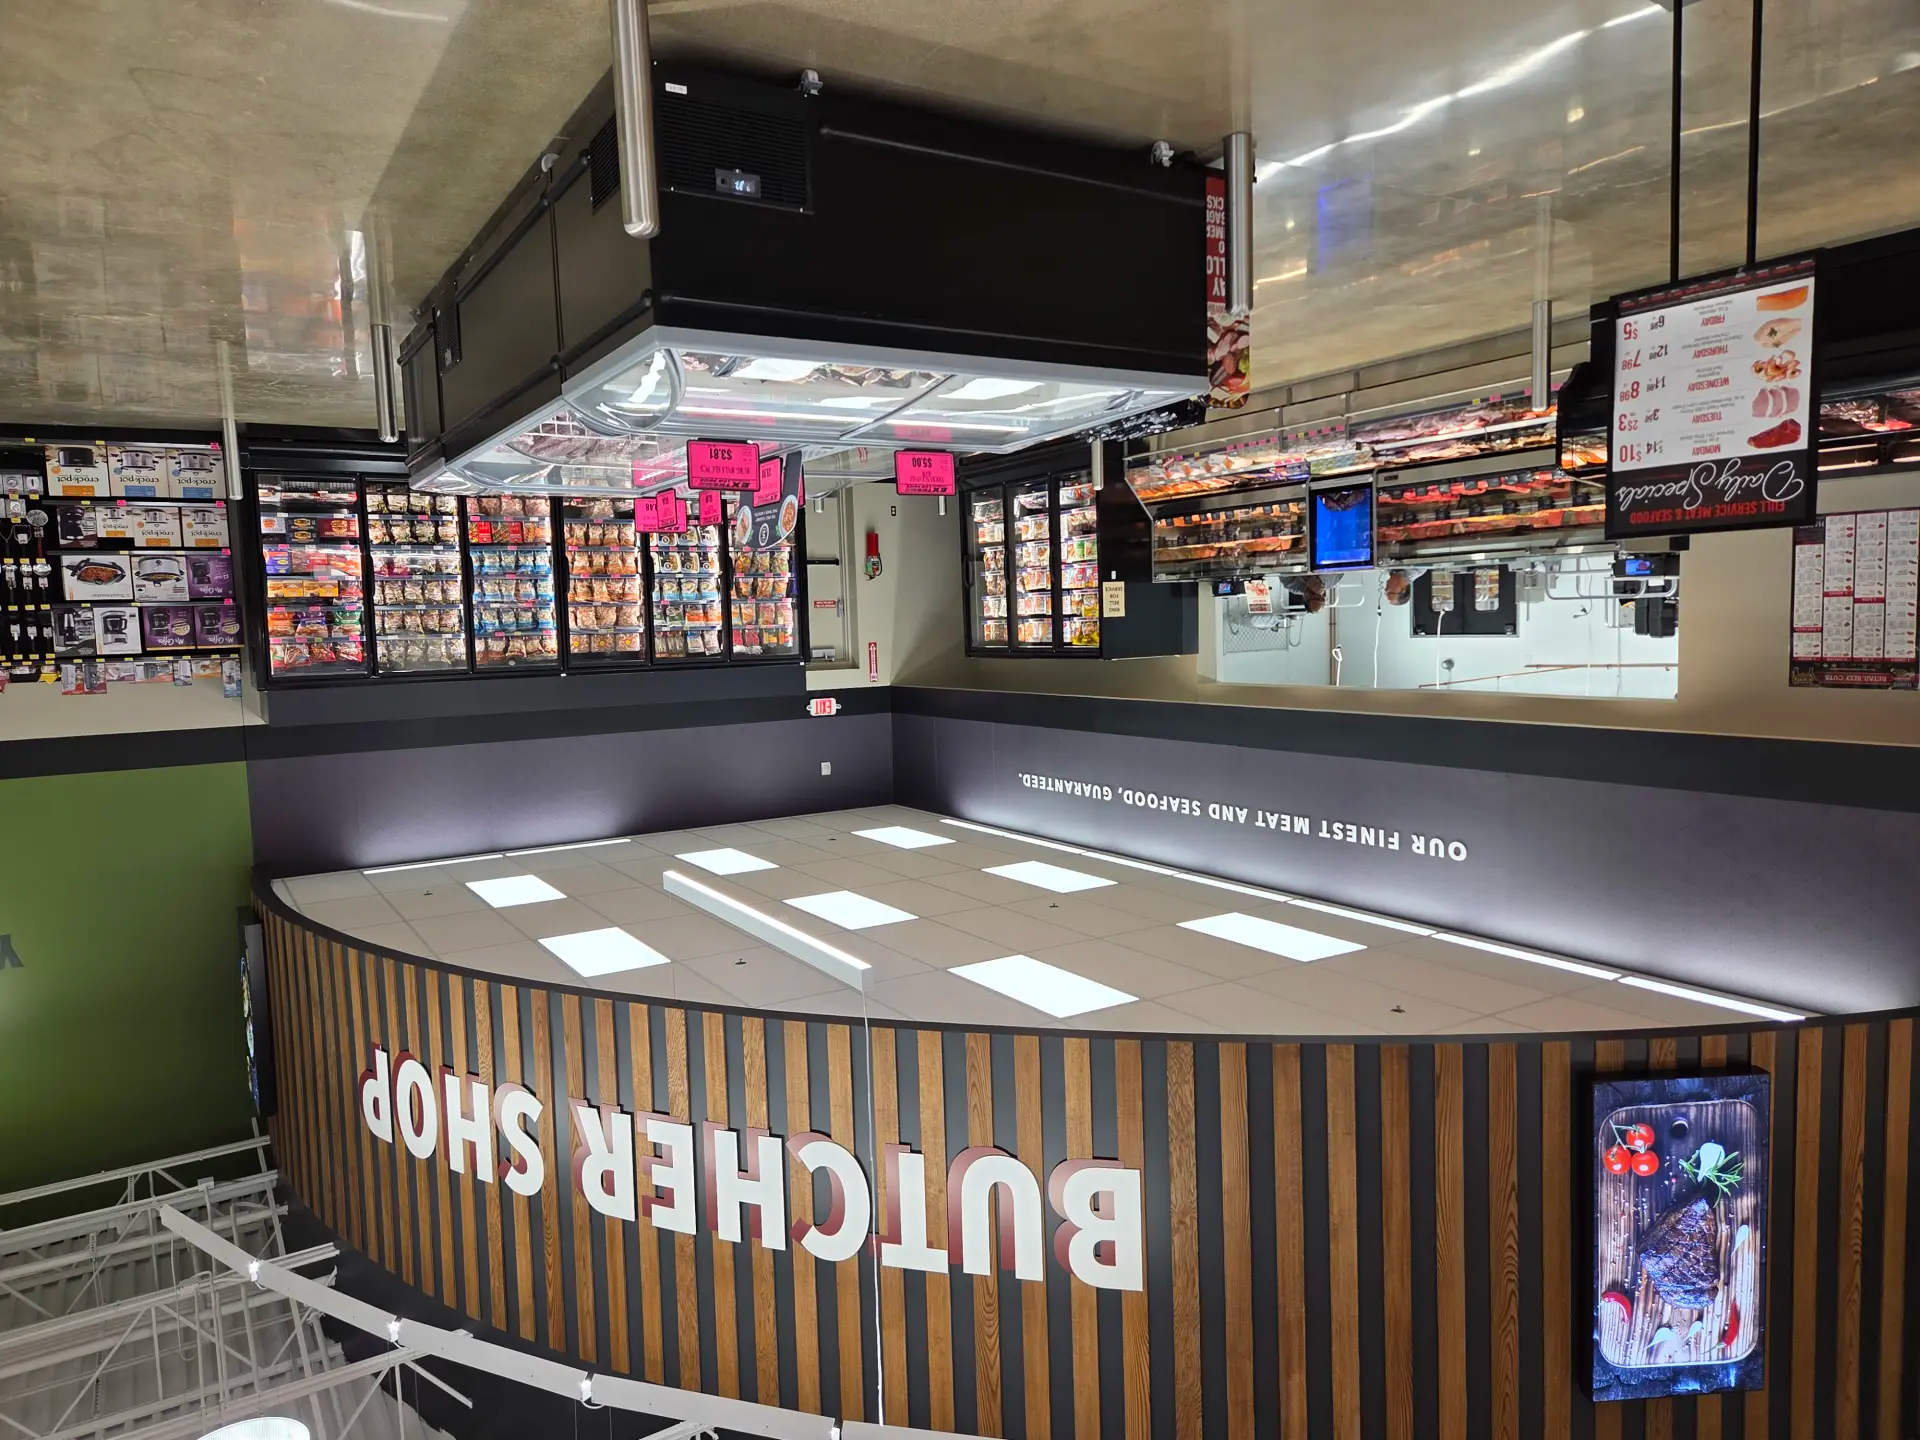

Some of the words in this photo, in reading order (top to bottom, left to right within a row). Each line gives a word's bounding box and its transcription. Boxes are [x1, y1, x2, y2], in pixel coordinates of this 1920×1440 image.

[1206, 194, 1224, 210] CKS
[1218, 240, 1225, 254] O
[1206, 255, 1226, 276] LLO
[1212, 276, 1226, 296] AY
[1701, 314, 1725, 327] FRIDAY
[1623, 322, 1638, 340] $5
[1692, 344, 1728, 359] THURSDAY
[1686, 376, 1730, 392] WEDNESDAY
[1692, 410, 1722, 424] TUESDAY
[710, 448, 732, 460] $3.81
[1619, 444, 1642, 462] $10
[1691, 444, 1721, 456] MONDAY
[912, 457, 932, 468] $5.00
[1614, 462, 1716, 511] Specials
[1714, 458, 1804, 502] Daily
[1684, 505, 1712, 520] MEAT
[1714, 501, 1757, 517] SERVICE
[1760, 499, 1785, 512] FULL
[1630, 509, 1673, 524] SEAFOOD
[1675, 509, 1682, 520] &
[815, 699, 832, 715] EXIT
[1018, 773, 1113, 801] GUARANTEED.
[1117, 787, 1201, 816] SEAFOOD,
[1207, 803, 1249, 824] AND
[1254, 809, 1311, 835] MEAT
[1318, 818, 1401, 851] FINEST
[1410, 834, 1468, 862] OUR
[360, 1047, 546, 1199] SHOP
[572, 1100, 1144, 1293] BUTCHER
